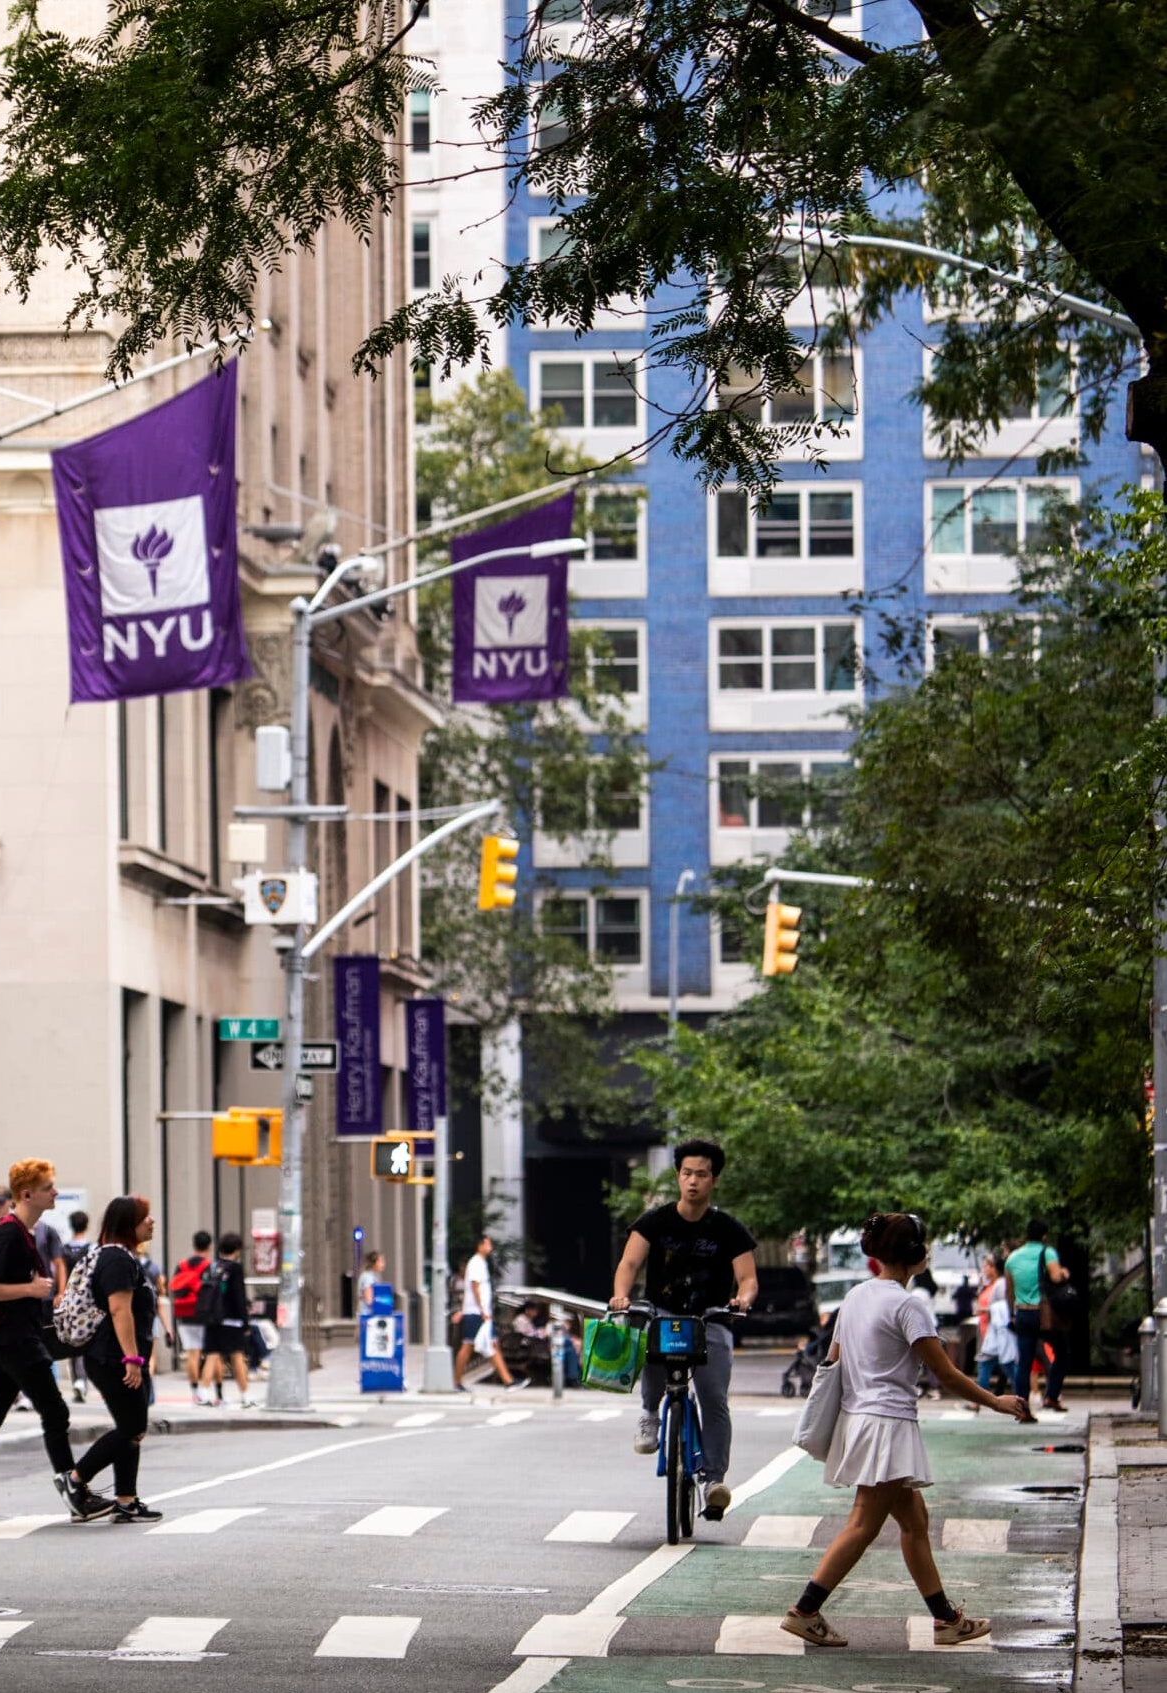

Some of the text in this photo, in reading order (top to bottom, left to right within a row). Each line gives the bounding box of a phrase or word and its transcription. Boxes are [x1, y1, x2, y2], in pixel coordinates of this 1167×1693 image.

[102, 609, 214, 662] NYU
[472, 649, 548, 679] NYU
[228, 1021, 241, 1037] W
[247, 1021, 257, 1037] 4
[342, 967, 363, 1123] Henry Kaufman
[413, 1008, 429, 1088] Kaufman
